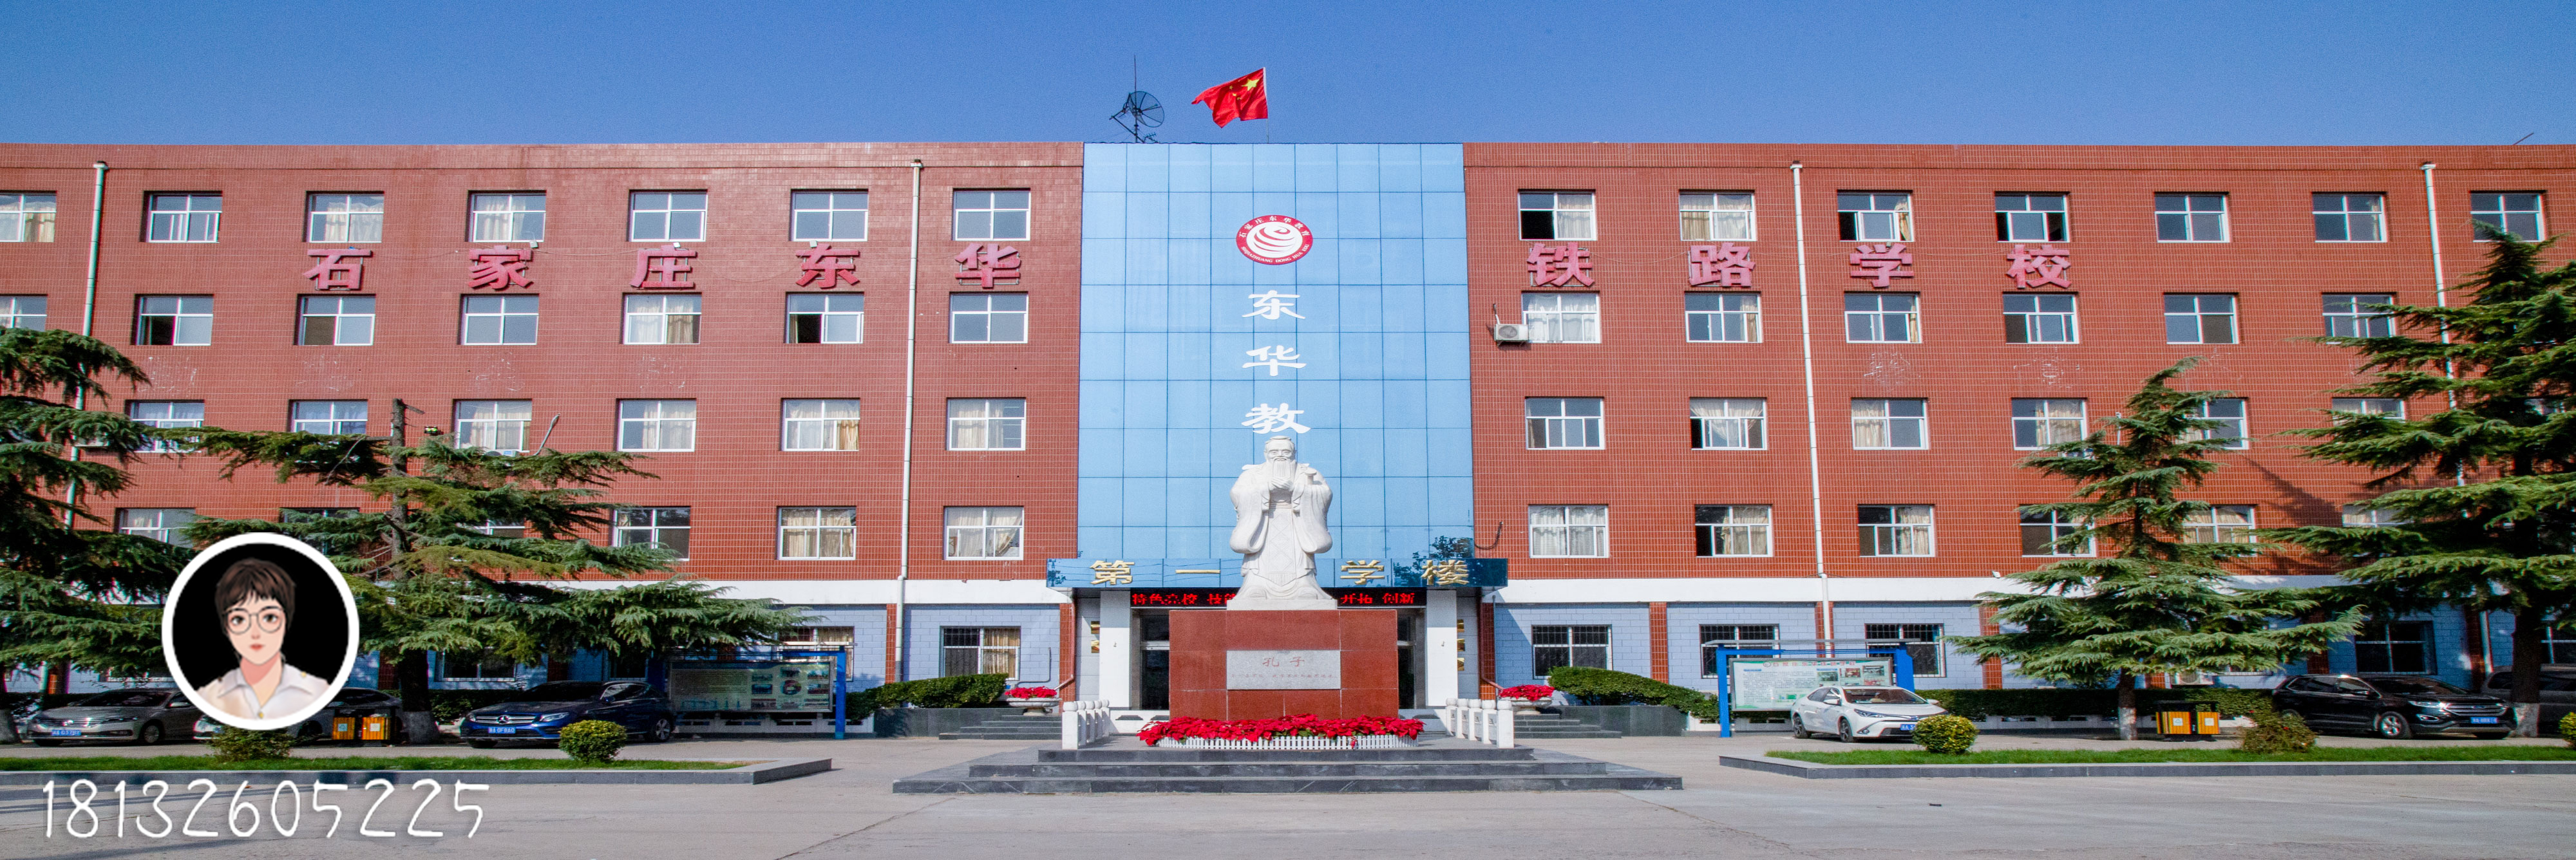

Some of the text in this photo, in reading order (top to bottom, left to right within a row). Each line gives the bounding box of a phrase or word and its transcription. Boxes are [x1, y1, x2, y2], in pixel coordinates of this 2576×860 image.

[303, 242, 2072, 291] 石家庄东华 铁路学校
[1340, 593, 1373, 604] 开拓
[1382, 592, 1415, 604] 创新
[1262, 656, 1305, 667] 孔子
